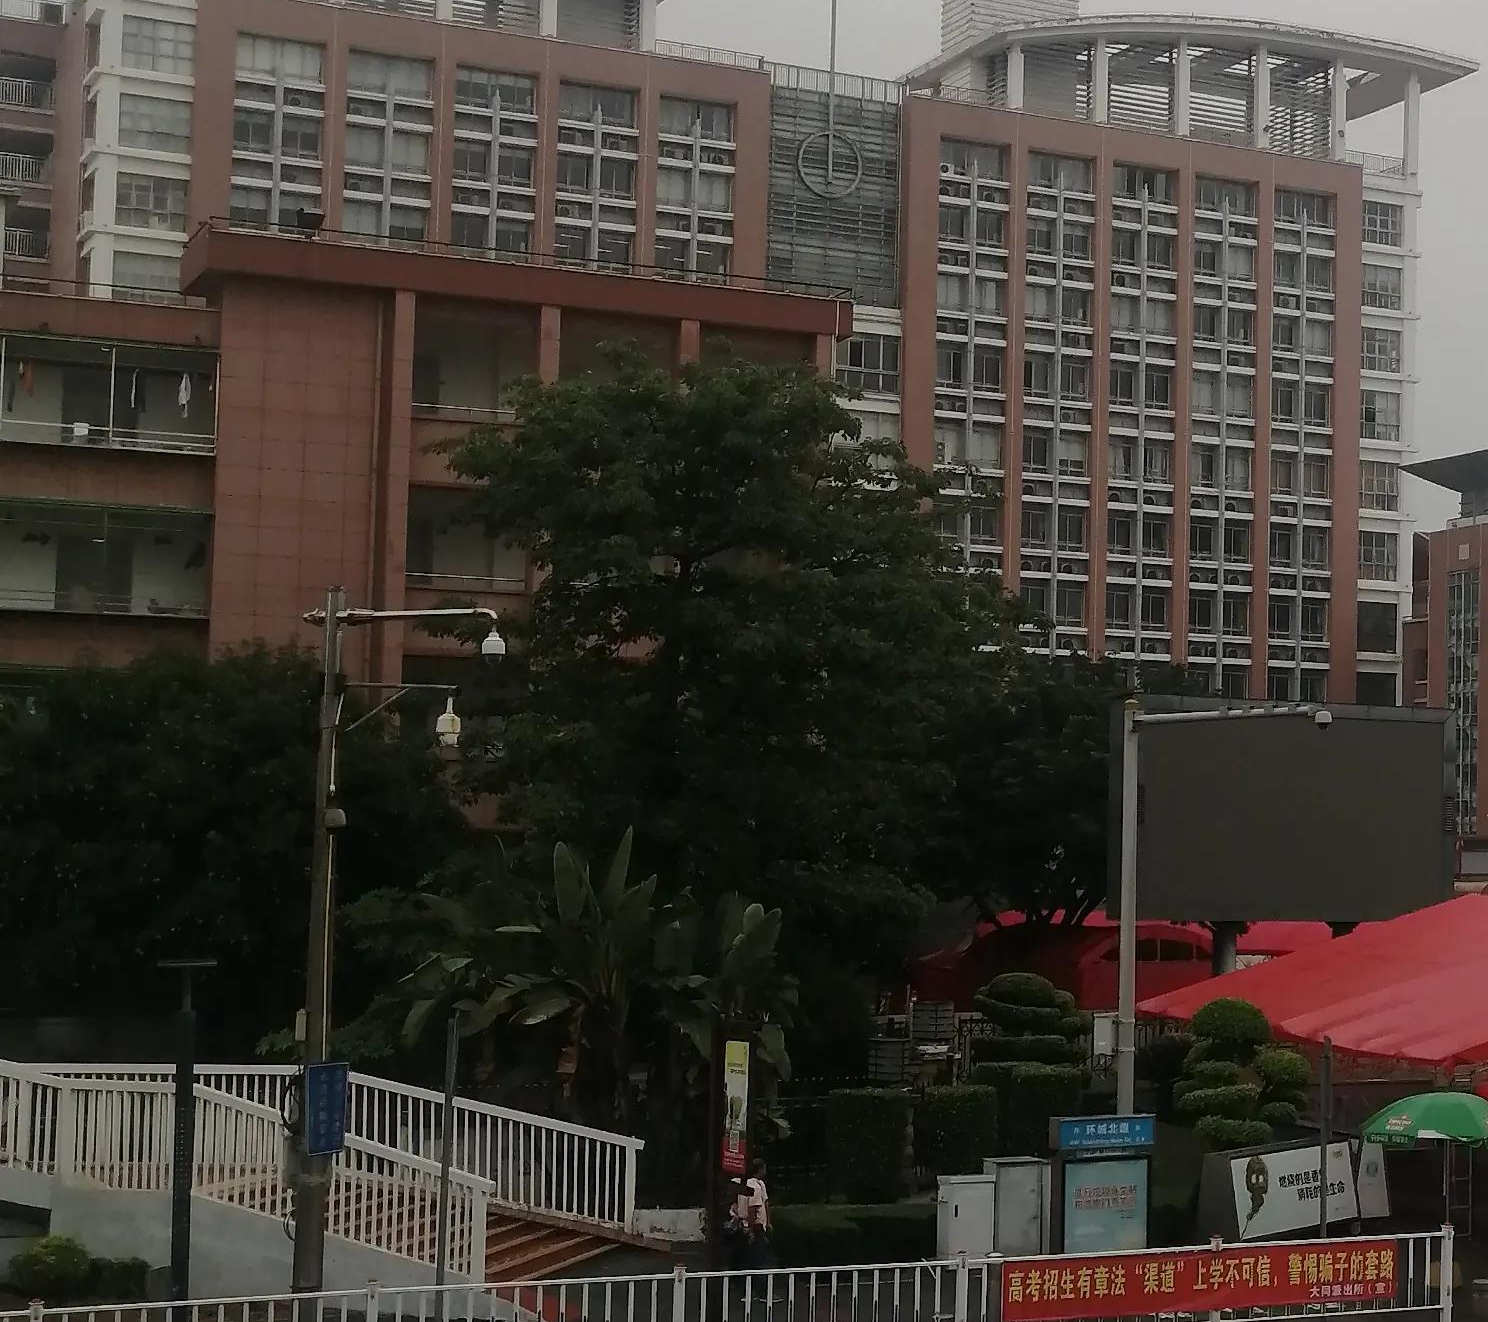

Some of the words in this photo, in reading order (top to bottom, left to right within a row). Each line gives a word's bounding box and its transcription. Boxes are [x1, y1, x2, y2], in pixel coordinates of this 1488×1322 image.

[1278, 1168, 1323, 1188] 燃烧的是香
